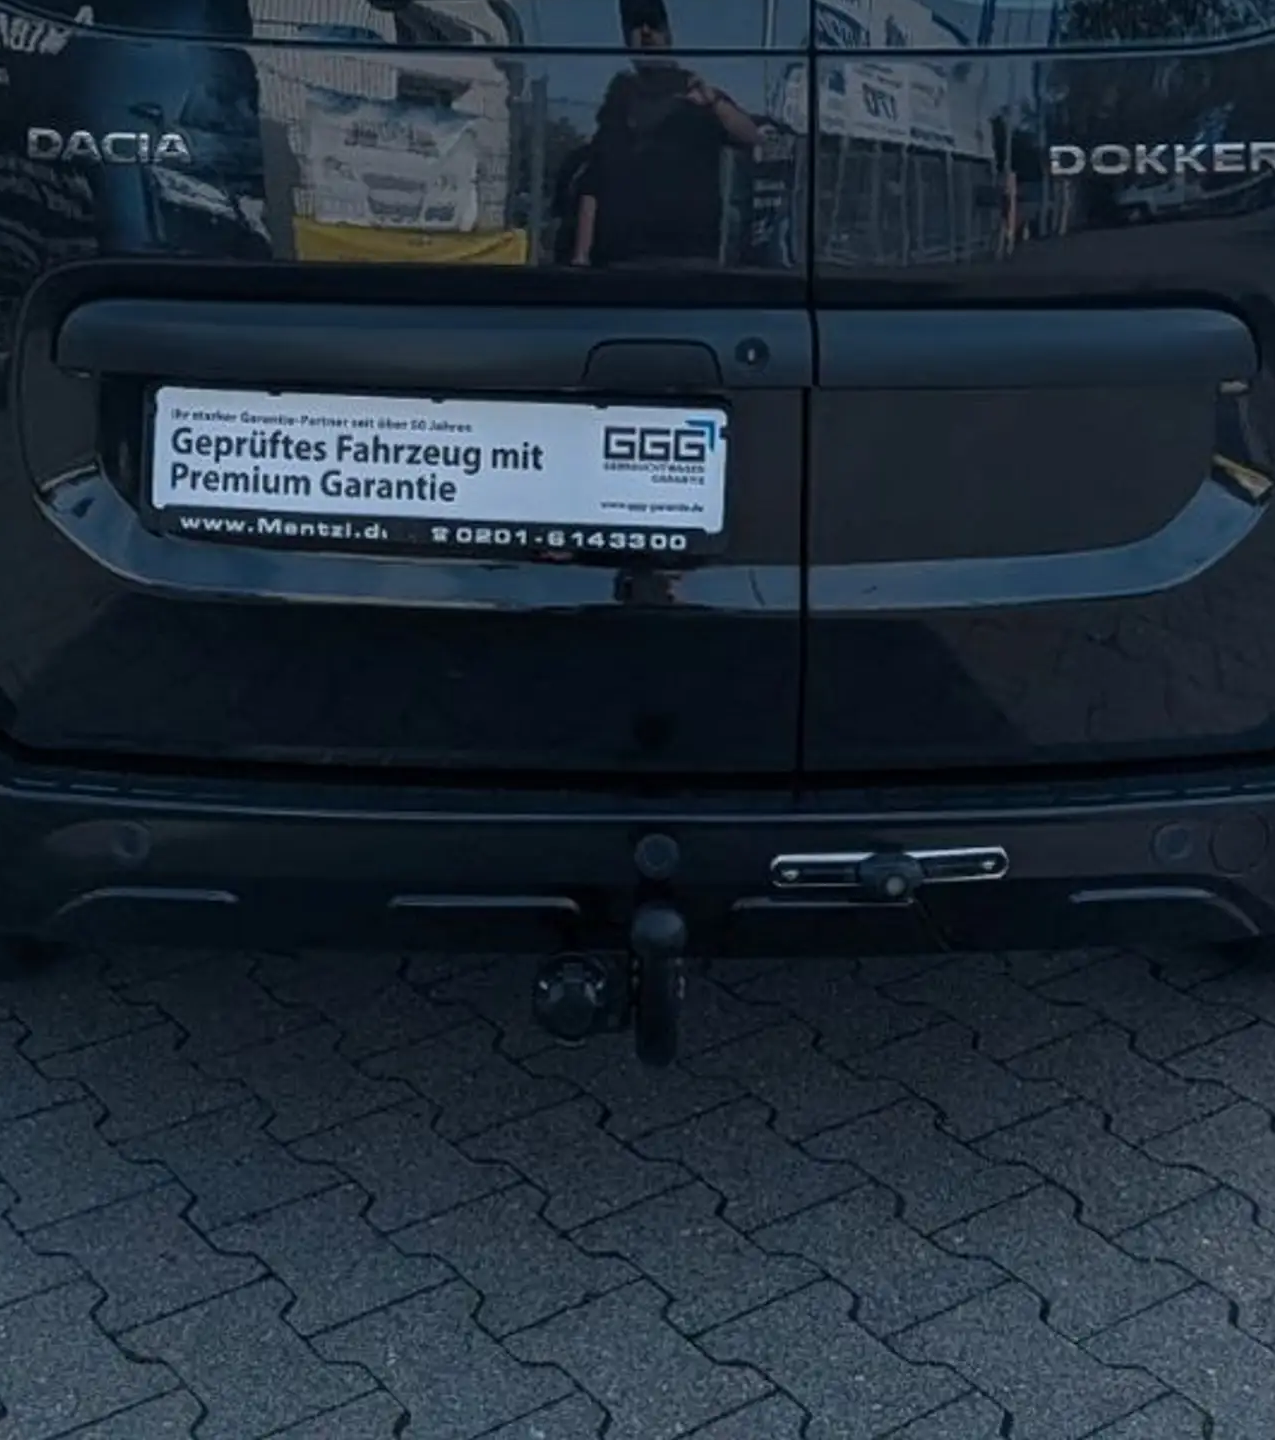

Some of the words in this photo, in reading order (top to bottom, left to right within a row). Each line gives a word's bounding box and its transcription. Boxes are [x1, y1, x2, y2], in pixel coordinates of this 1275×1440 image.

[27, 126, 192, 163] DACIA
[171, 427, 328, 463] Geprüftes
[336, 434, 482, 475] Fahrzeug
[491, 441, 544, 471] mit
[604, 426, 706, 462] GGG
[171, 462, 311, 497] Premium
[320, 469, 457, 502] Garantie
